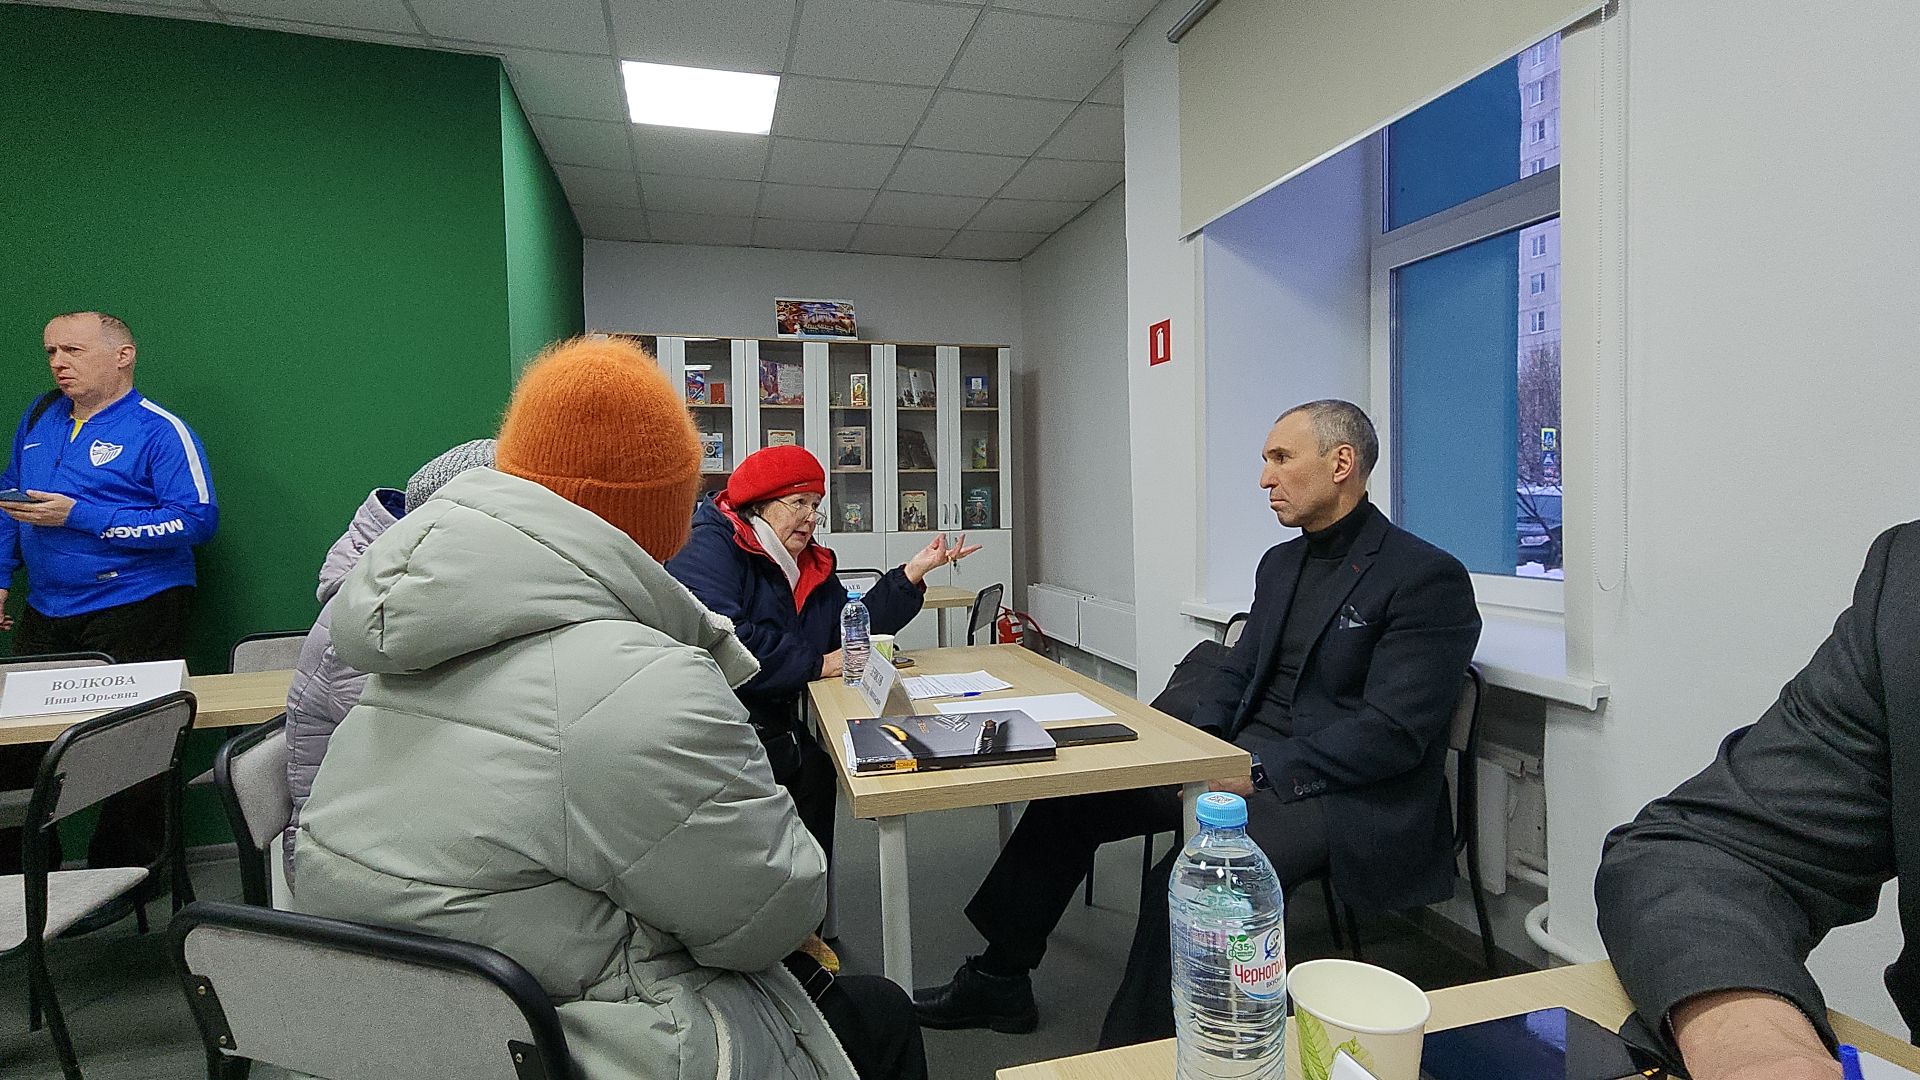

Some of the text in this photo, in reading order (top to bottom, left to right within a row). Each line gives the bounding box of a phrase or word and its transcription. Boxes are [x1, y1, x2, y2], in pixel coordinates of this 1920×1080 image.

[51, 675, 136, 692] ВОЛКОВА
[44, 691, 139, 706] Инна Юрьевна
